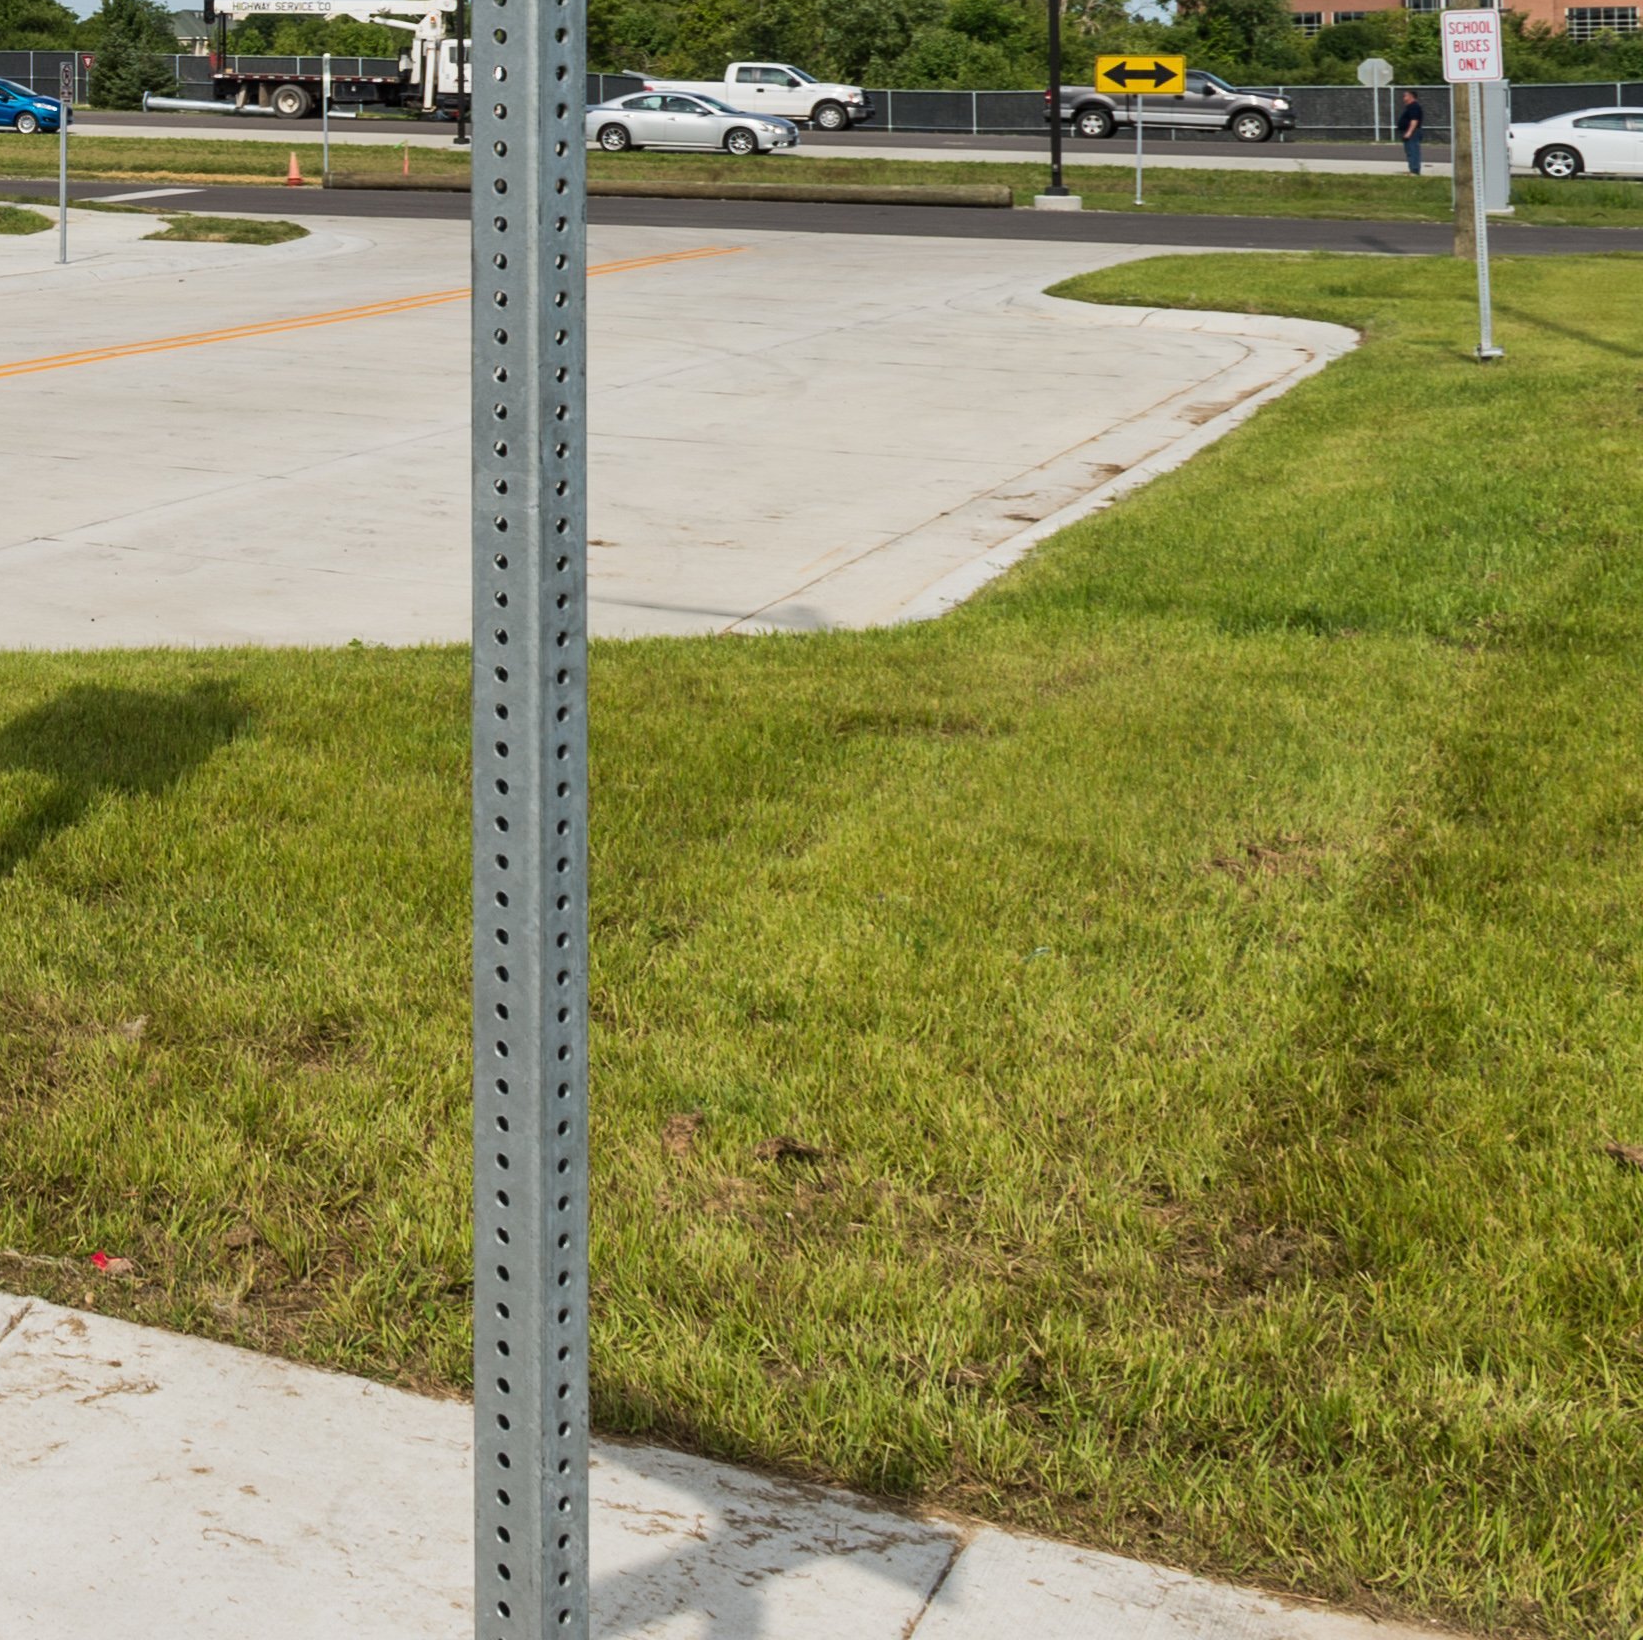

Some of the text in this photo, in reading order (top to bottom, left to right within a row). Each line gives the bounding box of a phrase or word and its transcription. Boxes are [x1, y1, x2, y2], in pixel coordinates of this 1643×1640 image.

[232, 1, 332, 11] HIGHWAY SERVICE CO
[1448, 21, 1494, 35] SCHOOL
[1453, 39, 1491, 53] BUSES
[1458, 58, 1488, 71] ONLY
